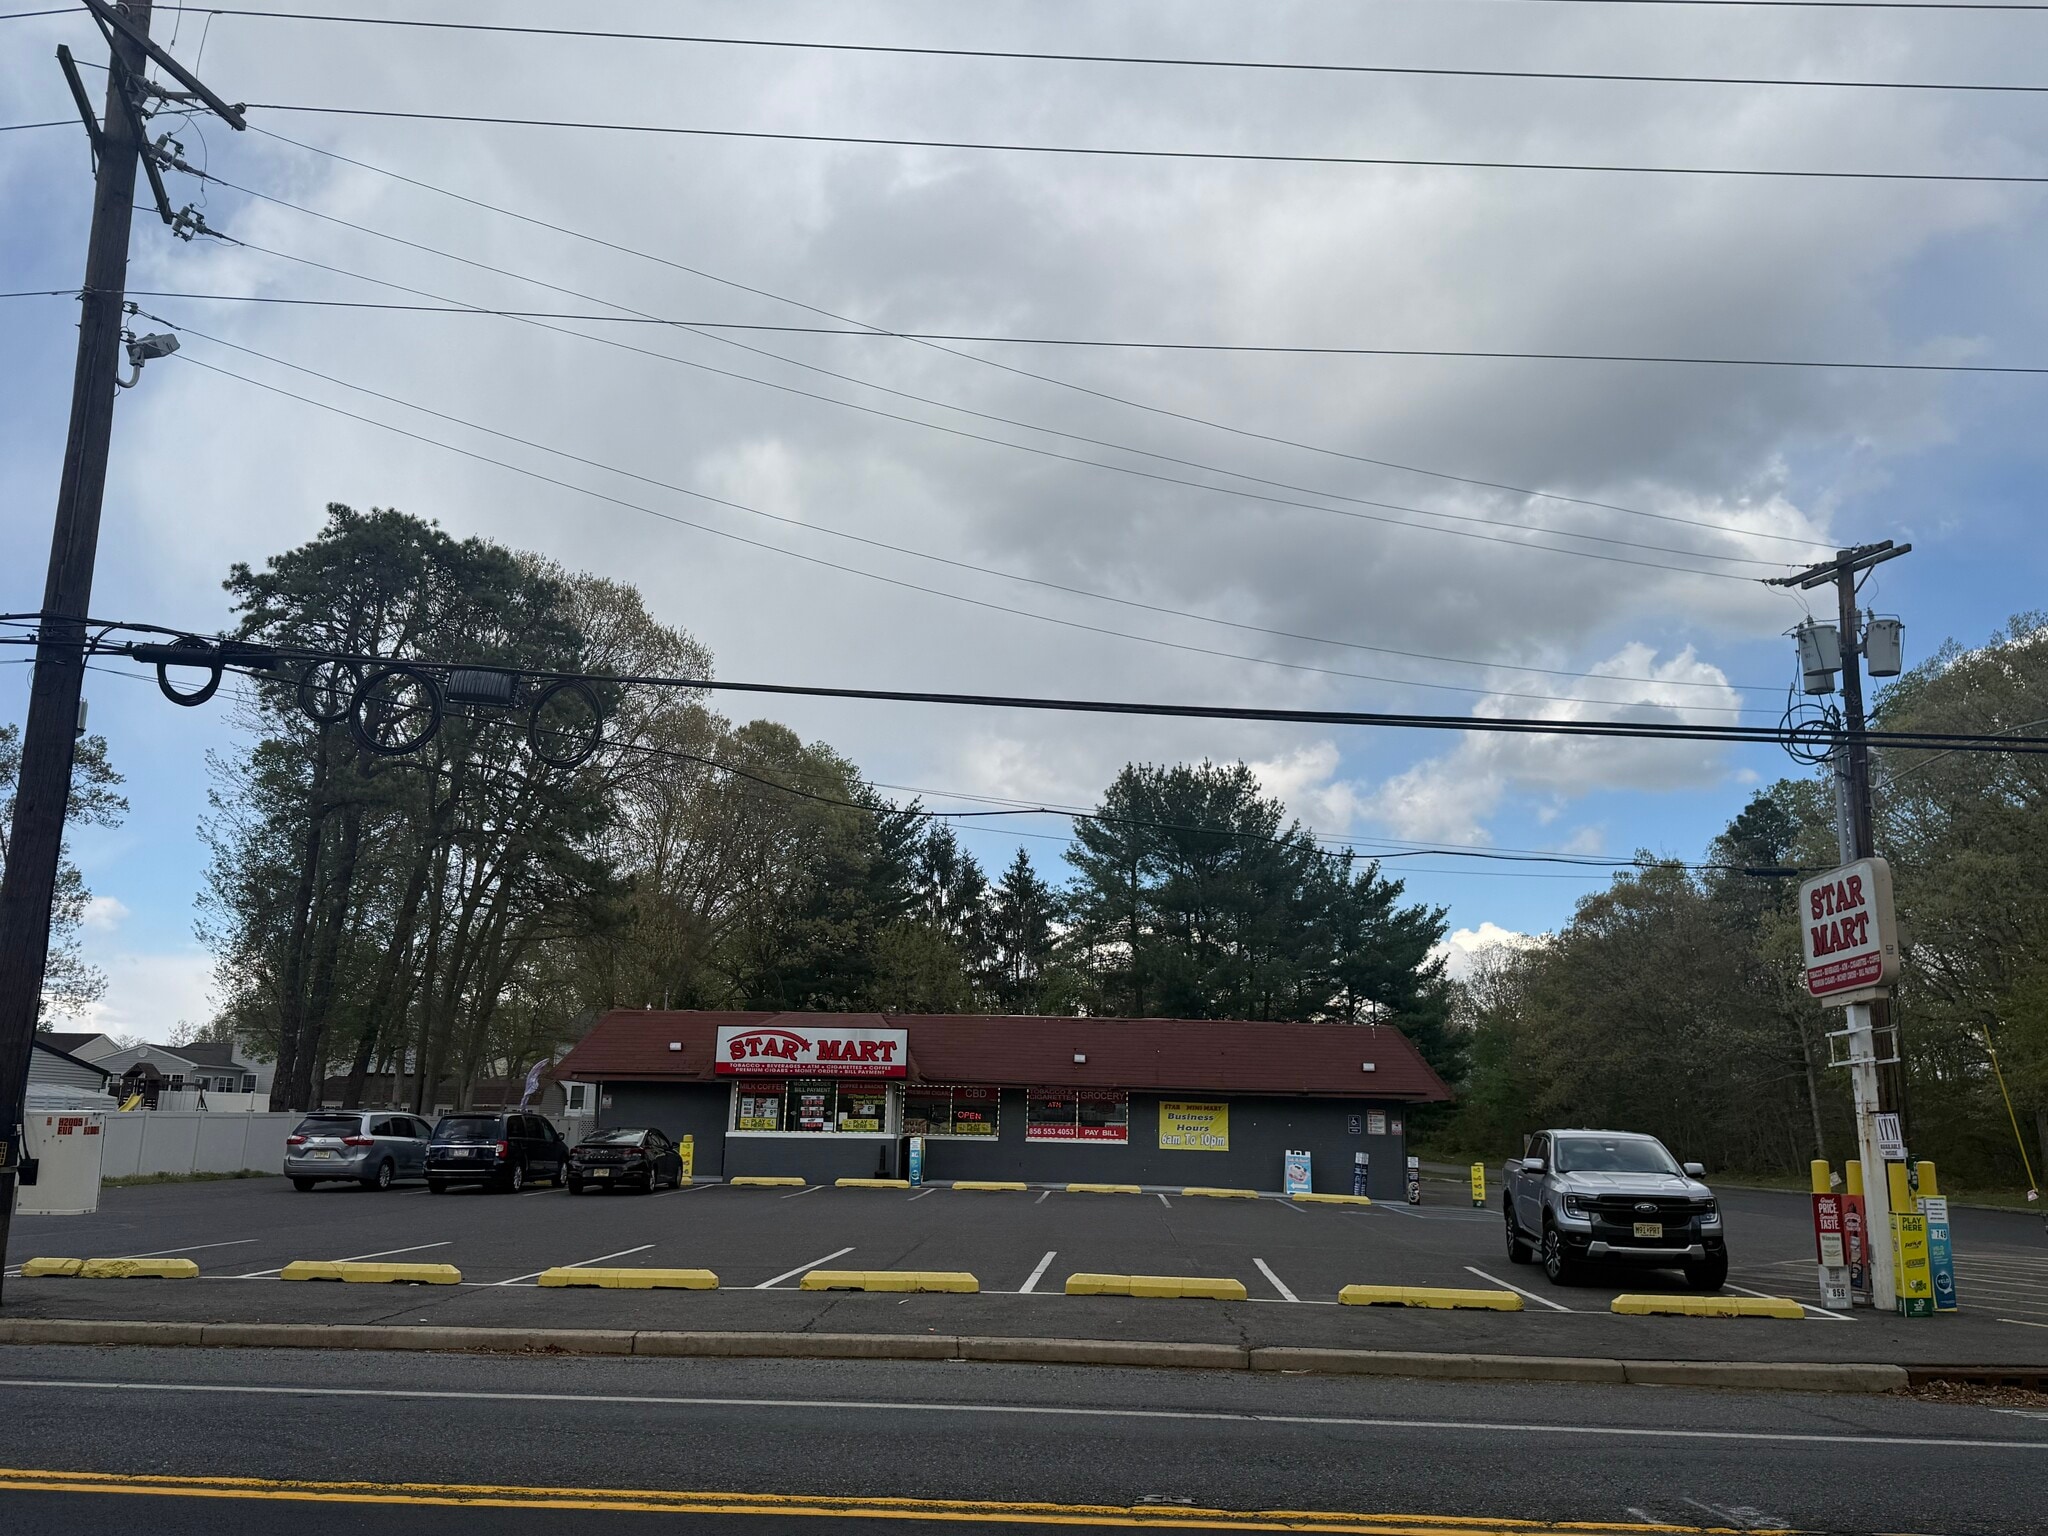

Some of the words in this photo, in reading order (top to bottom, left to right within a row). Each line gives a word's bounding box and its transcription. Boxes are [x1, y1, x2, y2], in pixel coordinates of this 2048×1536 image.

[1810, 875, 1865, 920] STAR
[1810, 911, 1869, 957] MART
[729, 1037, 800, 1061] STAR
[817, 1040, 897, 1062] MART
[965, 1089, 987, 1098] CBD
[1081, 1091, 1125, 1100] GROCERY
[957, 1111, 982, 1120] OPEN
[1168, 1112, 1214, 1121] Business
[1177, 1124, 1209, 1132] Hours
[1878, 1118, 1899, 1141] ATM
[1162, 1132, 1181, 1145] 6am
[1185, 1133, 1196, 1145] To
[1201, 1133, 1225, 1149] 10pm
[1818, 1203, 1839, 1214] PRICE.
[1820, 1219, 1840, 1230] TASTE.
[1902, 1217, 1921, 1225] PLAY
